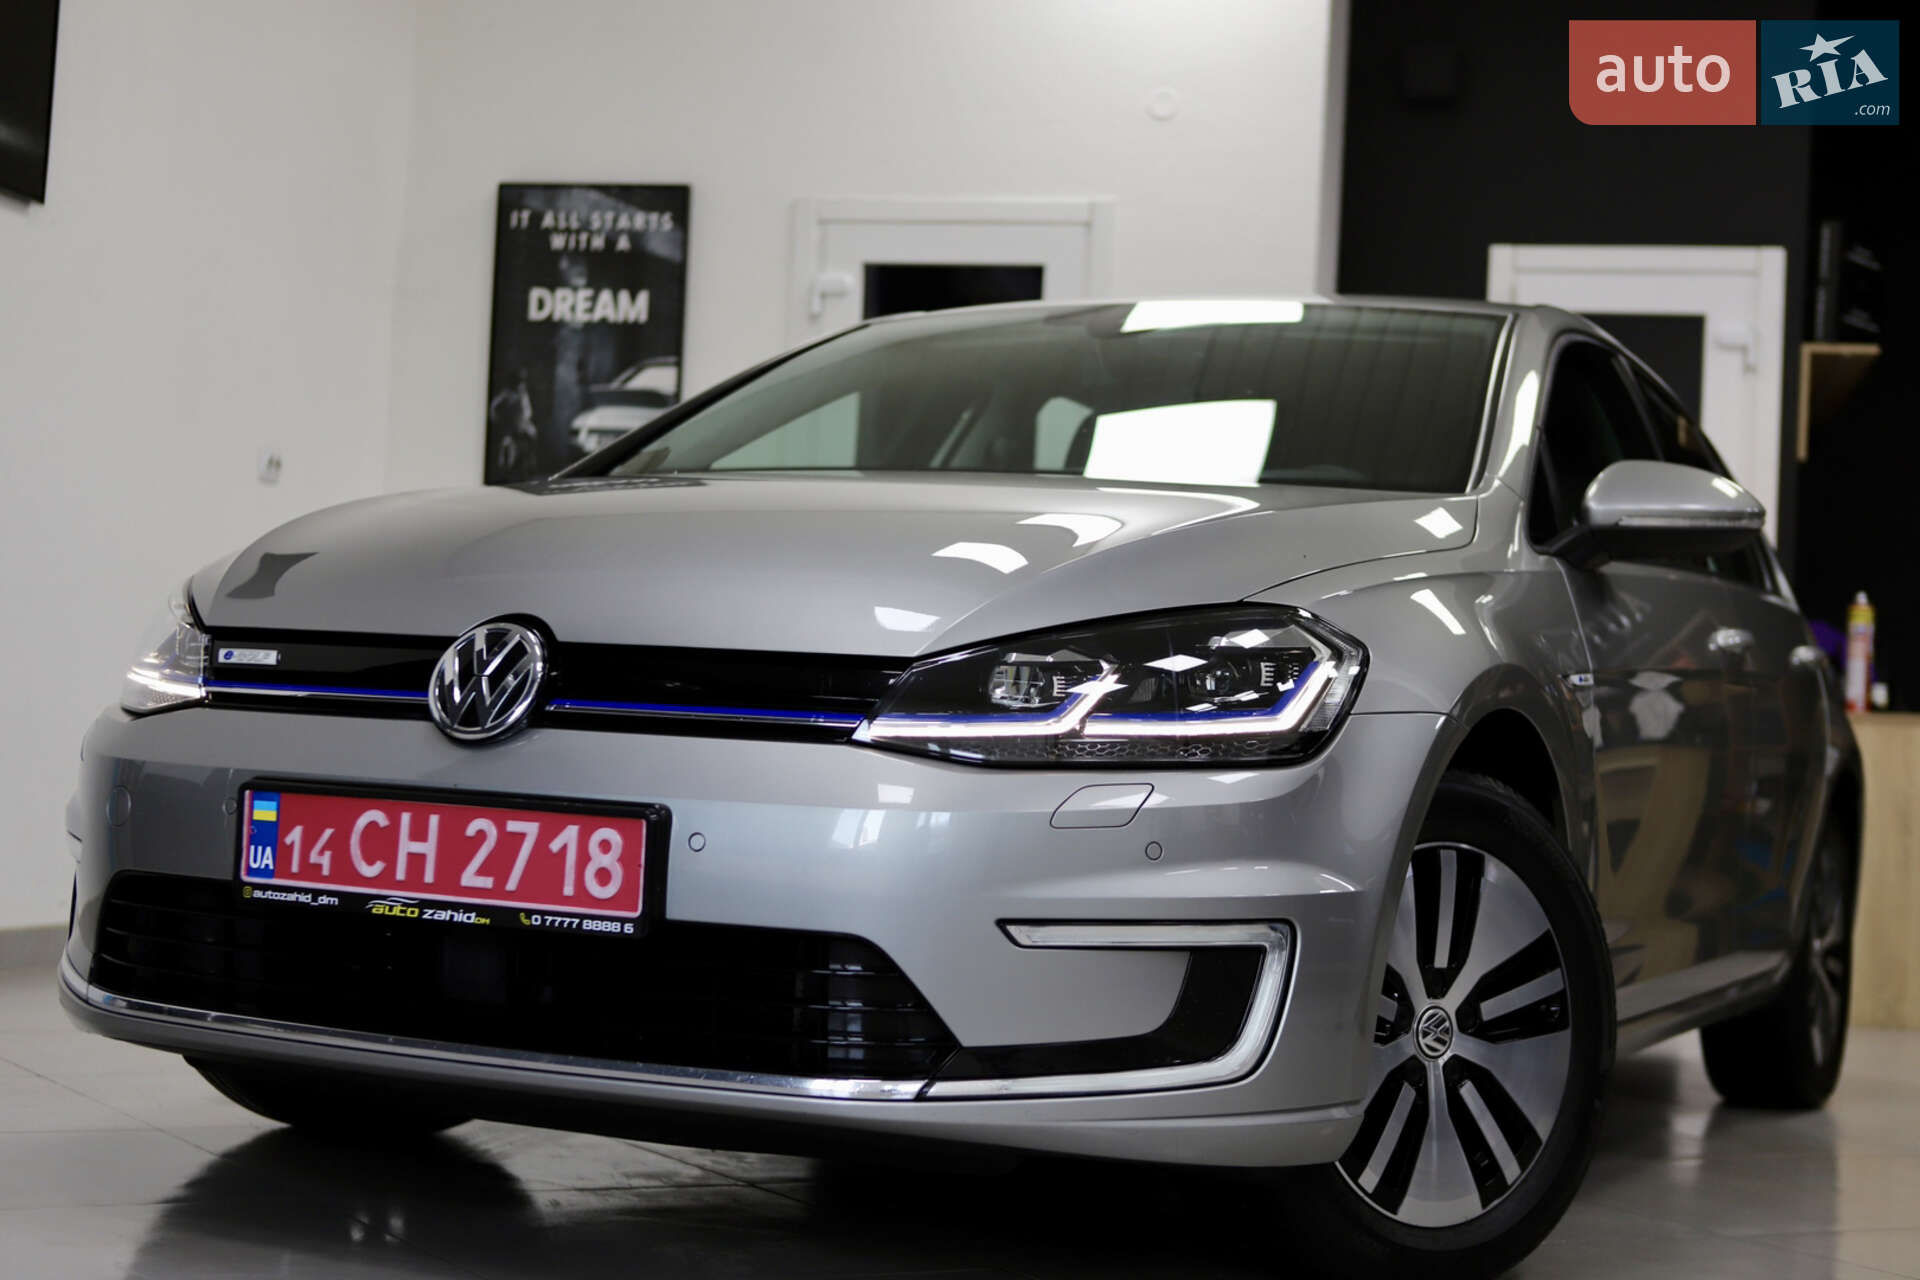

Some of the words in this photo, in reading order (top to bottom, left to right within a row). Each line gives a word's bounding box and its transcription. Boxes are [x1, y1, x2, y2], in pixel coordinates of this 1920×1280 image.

[509, 210, 531, 229] IT
[541, 210, 583, 229] ALL
[591, 211, 674, 232] STARTS
[549, 232, 605, 251] WITH
[615, 234, 632, 252] A
[527, 287, 651, 324] DREAM
[249, 845, 274, 870] UA
[284, 825, 335, 876] 14
[350, 809, 440, 883] CH
[460, 818, 624, 899] 2718
[371, 904, 420, 918] auto
[543, 916, 580, 929] 7777
[582, 919, 621, 933] 8888
[623, 923, 634, 934] 6
